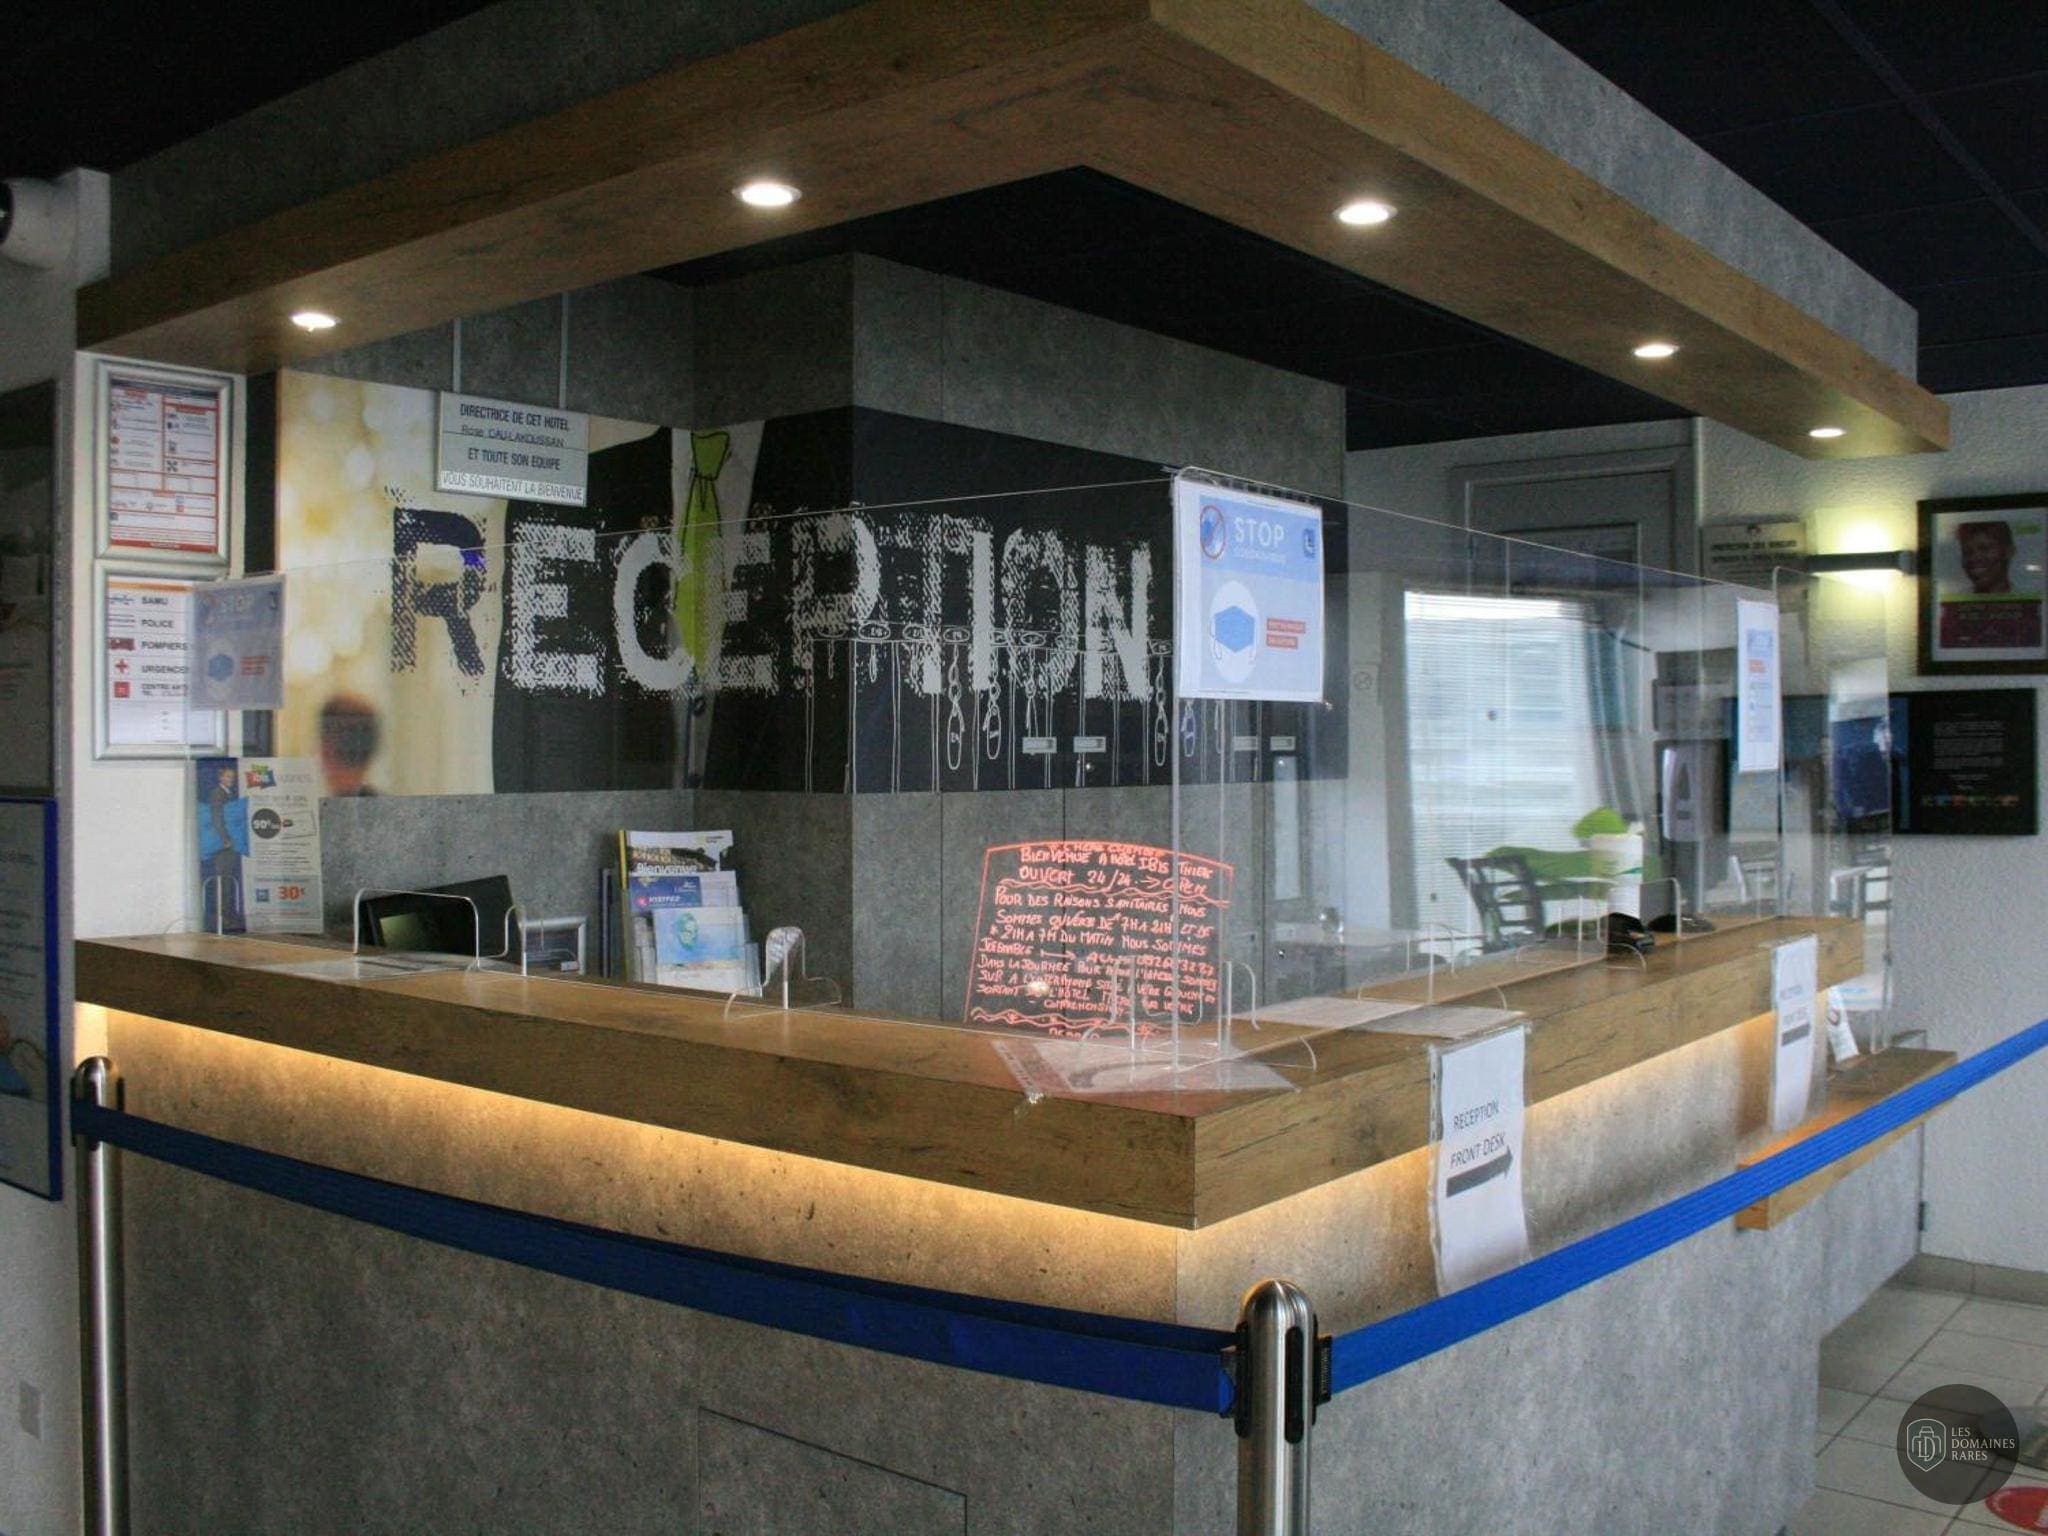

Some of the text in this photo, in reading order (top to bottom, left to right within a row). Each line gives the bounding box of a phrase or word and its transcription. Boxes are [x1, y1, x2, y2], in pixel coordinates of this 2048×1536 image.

[460, 404, 569, 431] DIRECTRICE DE CET HOTEL
[468, 448, 561, 471] ET TOUTE SON EQUIPE
[443, 471, 583, 500] VOUS SOUHAITENT LA BIENVENUE
[1233, 516, 1286, 548] STOP
[390, 502, 1154, 701] RECEPTION
[141, 619, 174, 628] POLICE
[141, 641, 189, 650] POMPIERS
[994, 885, 1022, 905] POUR
[1027, 894, 1049, 906] DES
[1452, 1100, 1500, 1130] RECEPTION
[1451, 1132, 1506, 1167] FRONT DESK
